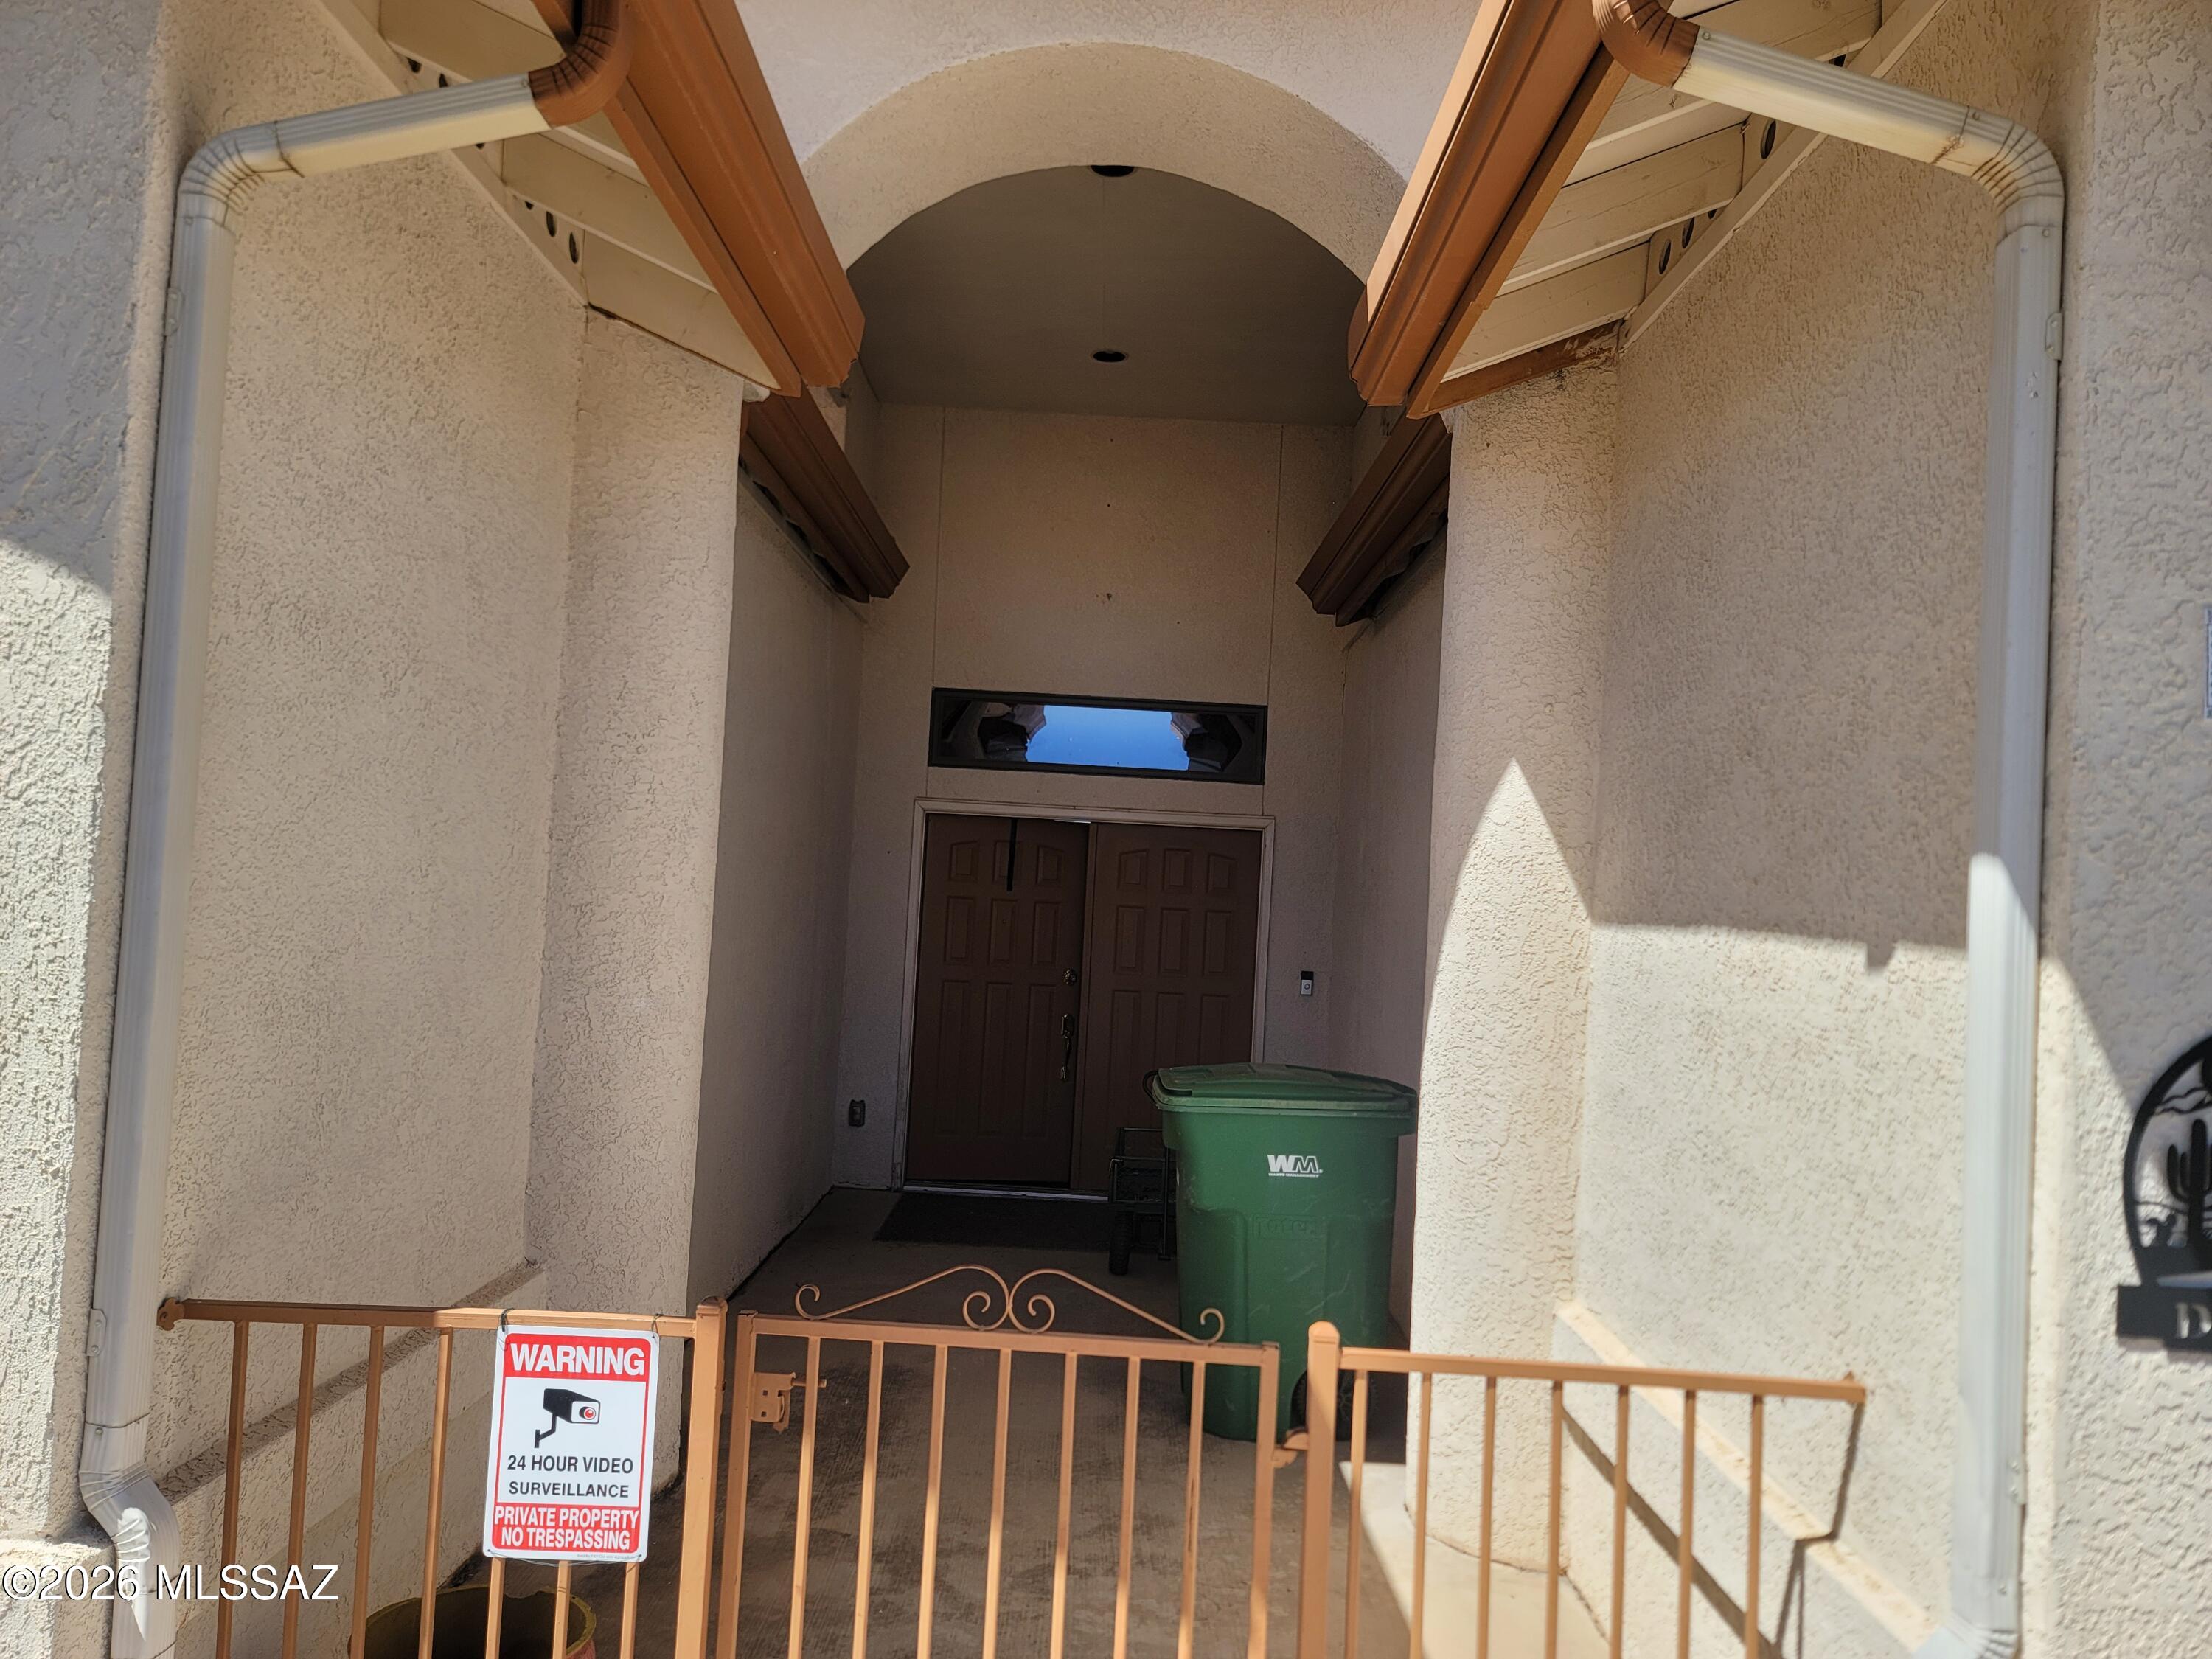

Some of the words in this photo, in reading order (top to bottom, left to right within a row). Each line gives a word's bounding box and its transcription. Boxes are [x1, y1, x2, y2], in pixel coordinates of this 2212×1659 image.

[1267, 1155, 1319, 1173] WM
[510, 1343, 645, 1376] WARNING
[507, 1454, 526, 1470] 24
[531, 1455, 578, 1472] HOUR
[583, 1456, 634, 1474] VIDEO
[509, 1481, 629, 1498] SURVEILLANCE
[494, 1506, 556, 1527] PRIVATE
[559, 1508, 639, 1529] PROPERTY
[501, 1526, 524, 1547] NO
[526, 1528, 630, 1550] TRESPASSING
